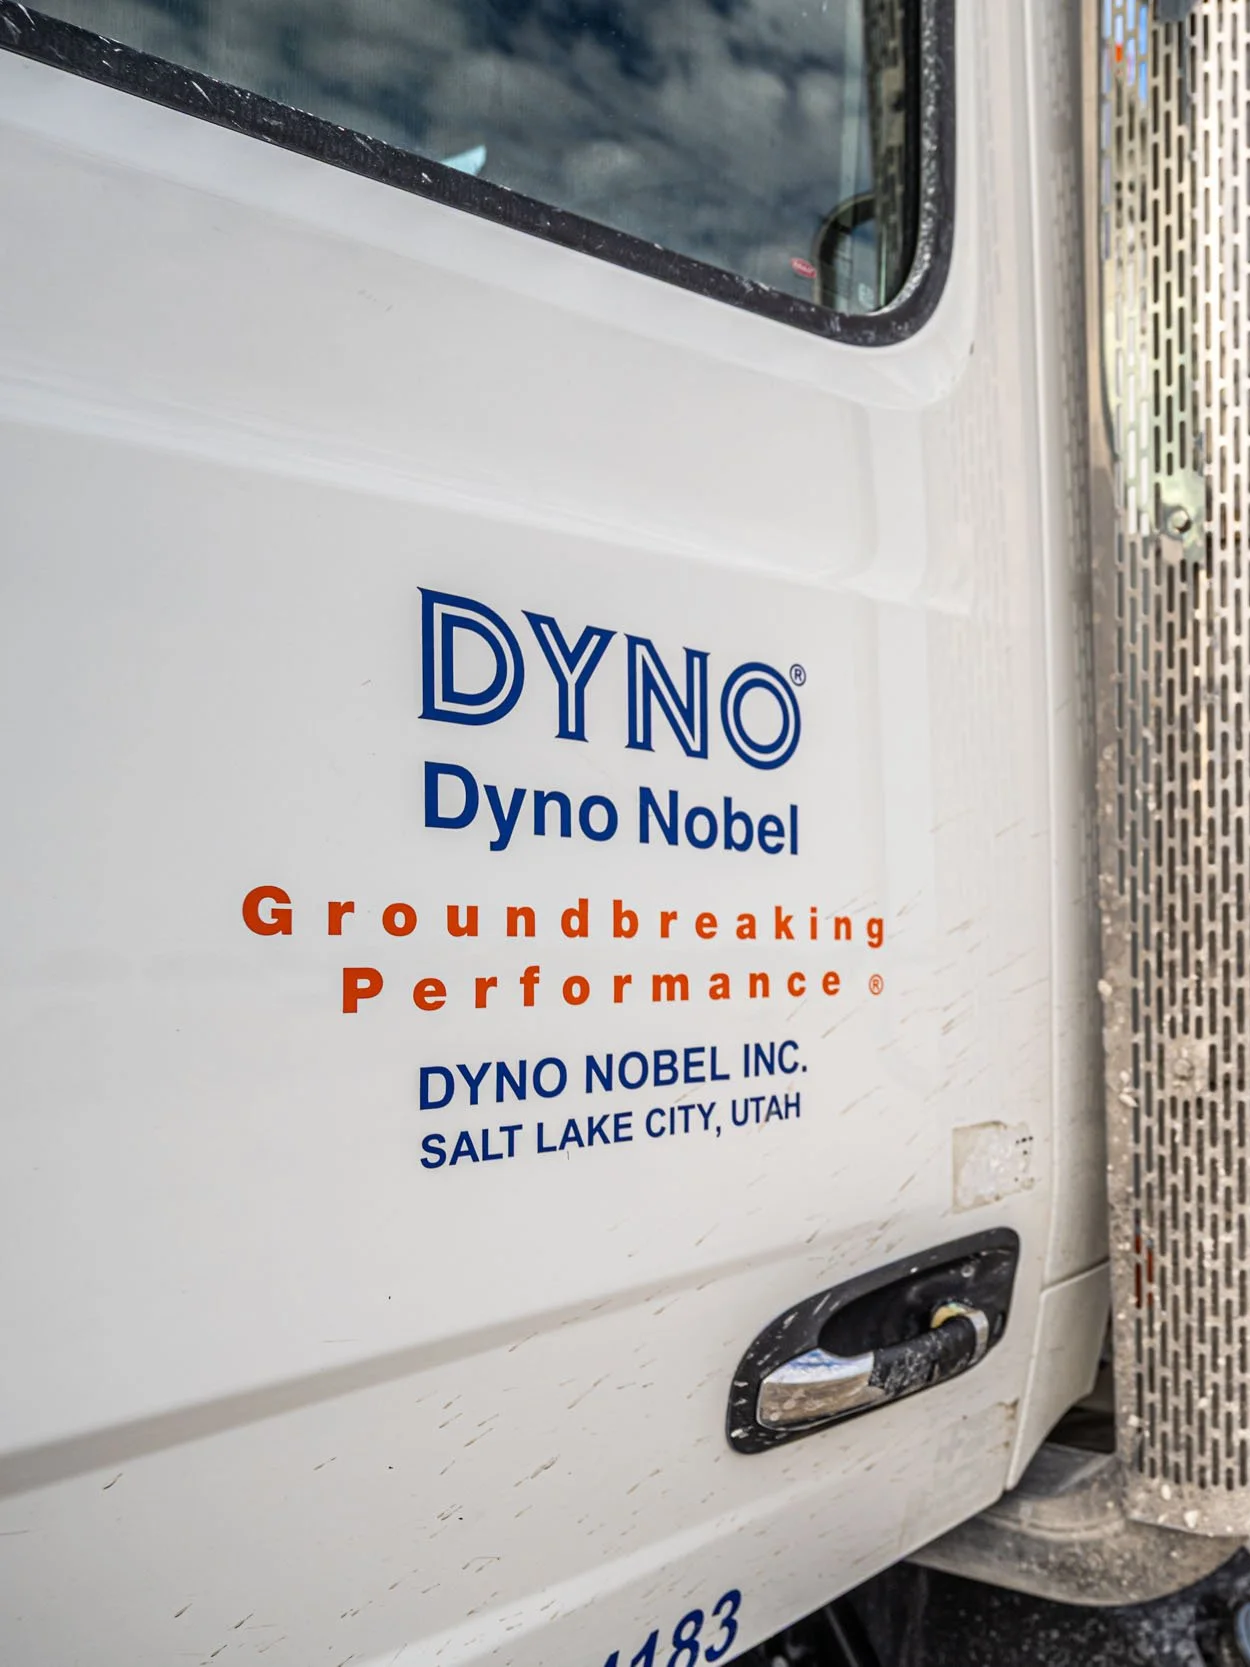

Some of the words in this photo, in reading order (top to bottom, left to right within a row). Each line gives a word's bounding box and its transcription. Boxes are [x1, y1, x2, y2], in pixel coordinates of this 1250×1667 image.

[424, 761, 618, 852] Dyno
[639, 786, 799, 855] Nobel
[241, 885, 885, 949] Groundbreaking
[342, 965, 841, 1014] Performance
[419, 1057, 567, 1110] DYNO
[585, 1046, 730, 1094] NOBEL
[743, 1040, 808, 1078] INC.
[420, 1125, 523, 1169] SALT
[536, 1112, 634, 1154] LAKE
[645, 1100, 722, 1138] CITY,
[731, 1092, 801, 1127] UTAH
